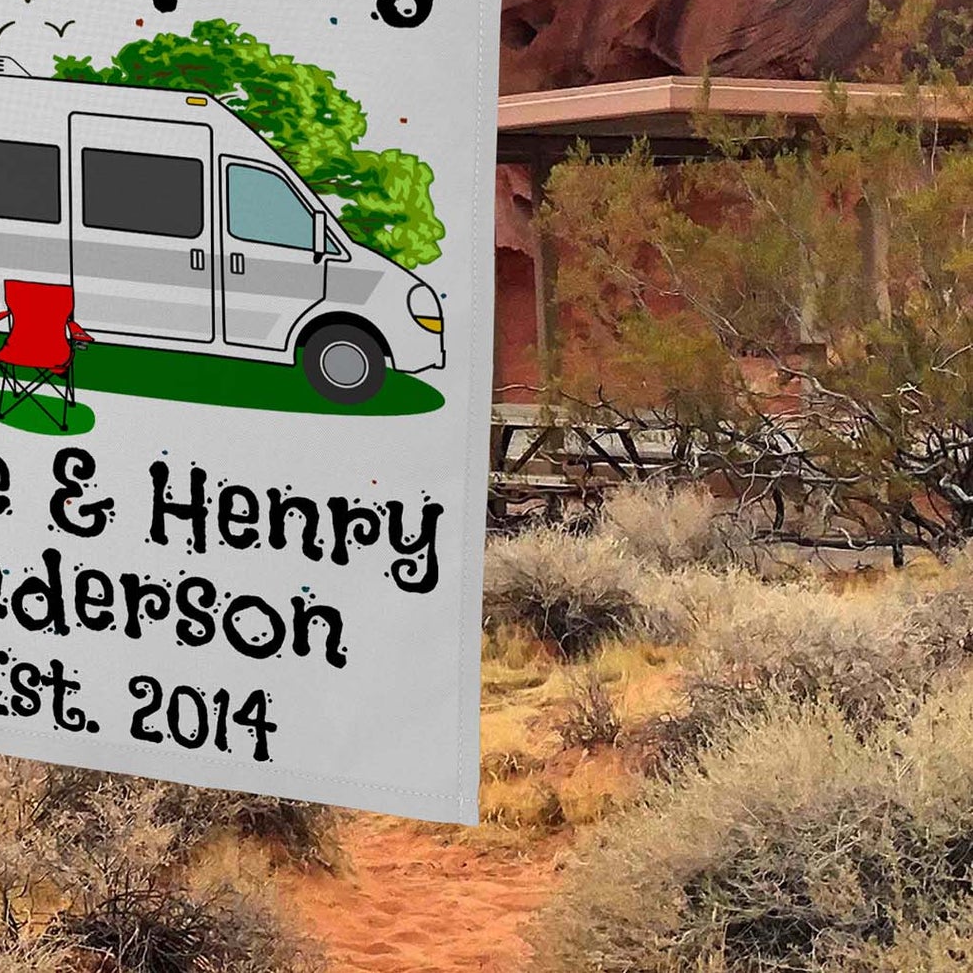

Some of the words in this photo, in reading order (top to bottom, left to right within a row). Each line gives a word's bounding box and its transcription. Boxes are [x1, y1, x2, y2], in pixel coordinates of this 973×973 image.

[48, 447, 115, 537] &
[145, 460, 444, 594] Henry
[128, 675, 278, 762] 2014
